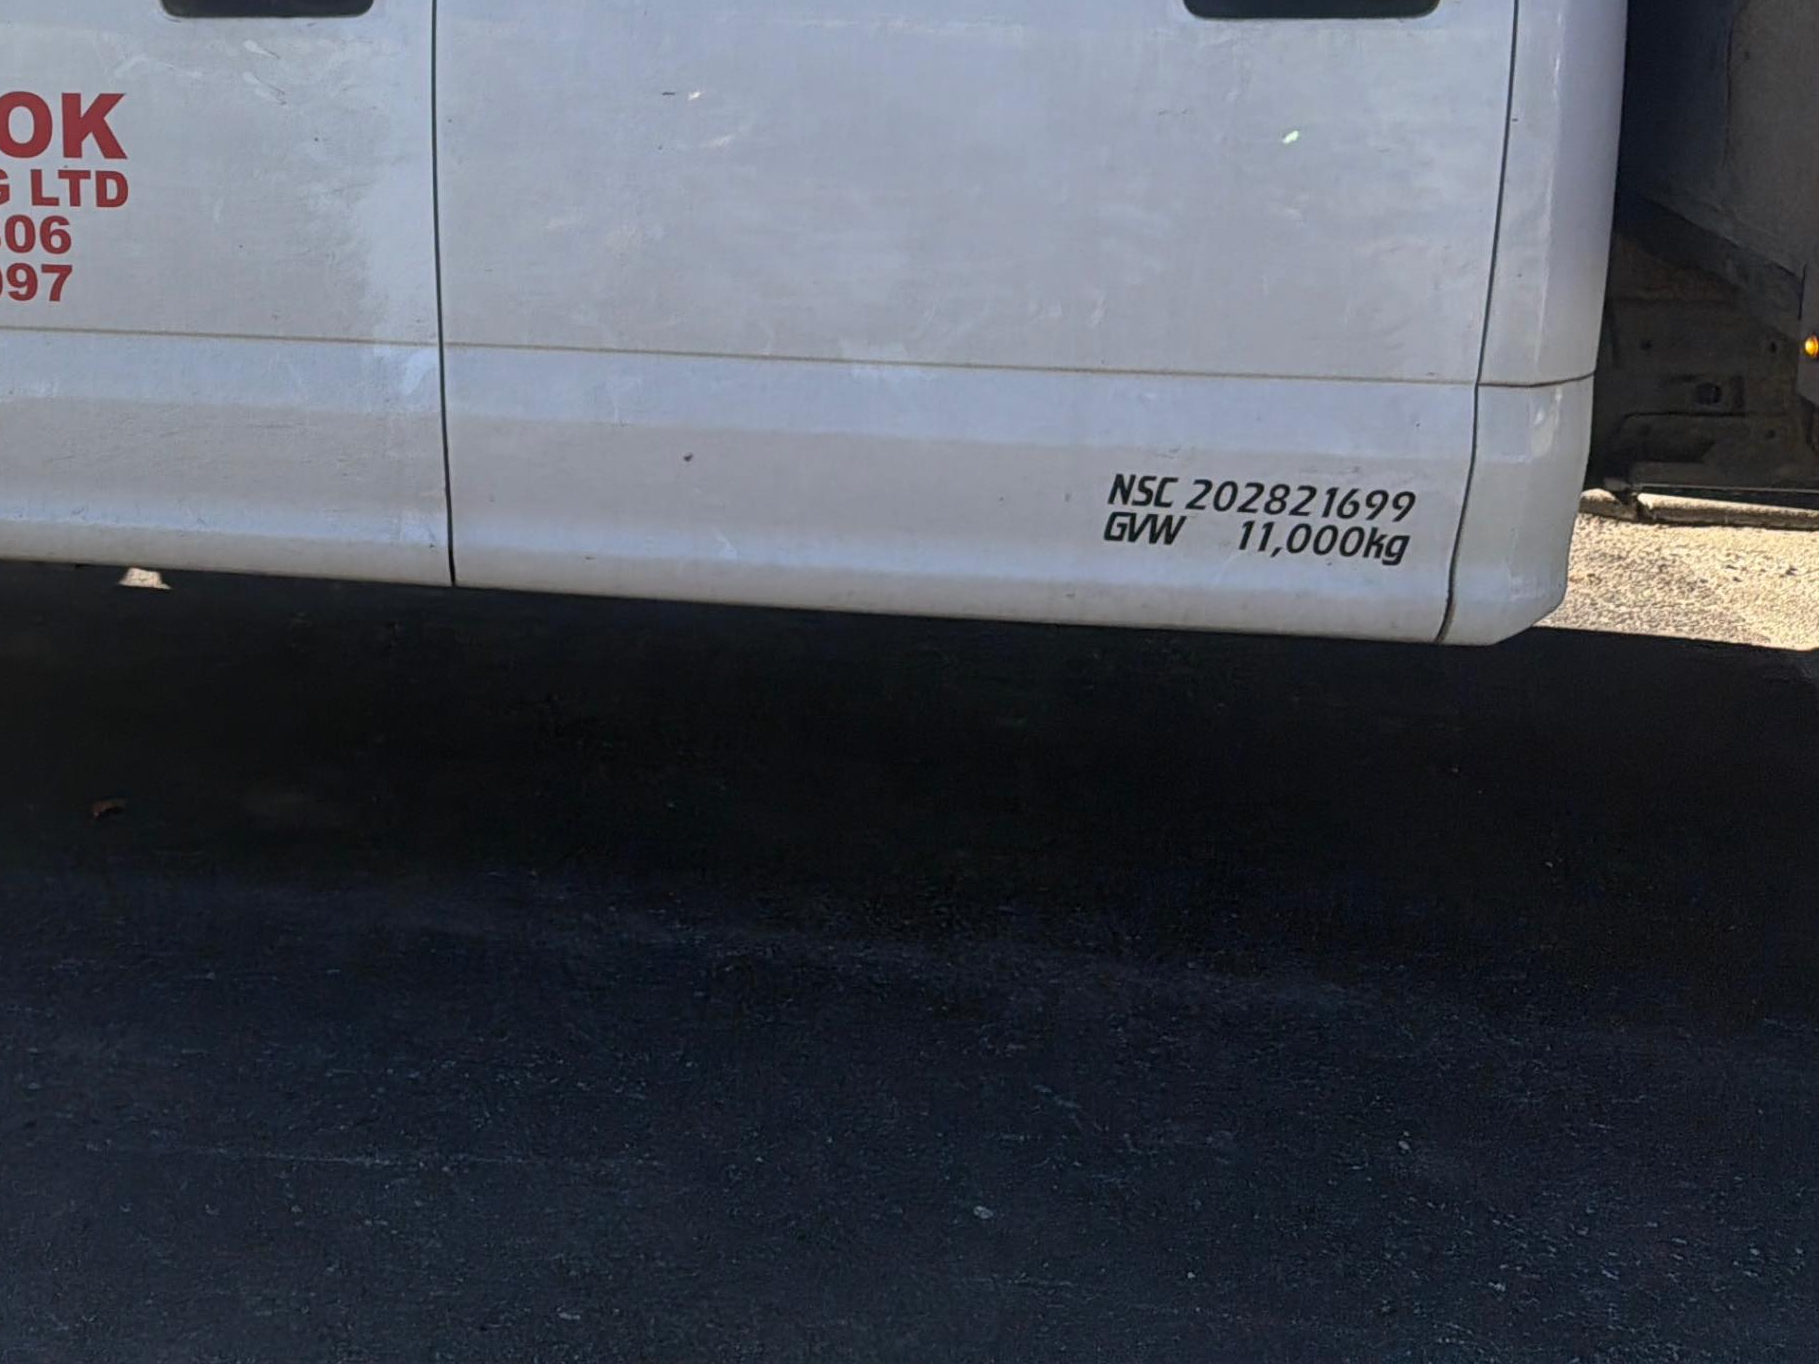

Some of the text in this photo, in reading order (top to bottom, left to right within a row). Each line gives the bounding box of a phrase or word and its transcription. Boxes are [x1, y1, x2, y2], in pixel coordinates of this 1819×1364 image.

[30, 169, 129, 208] LTD
[1107, 473, 1417, 523] NSC 202821699
[1103, 511, 1411, 566] GVW 11,000kg
